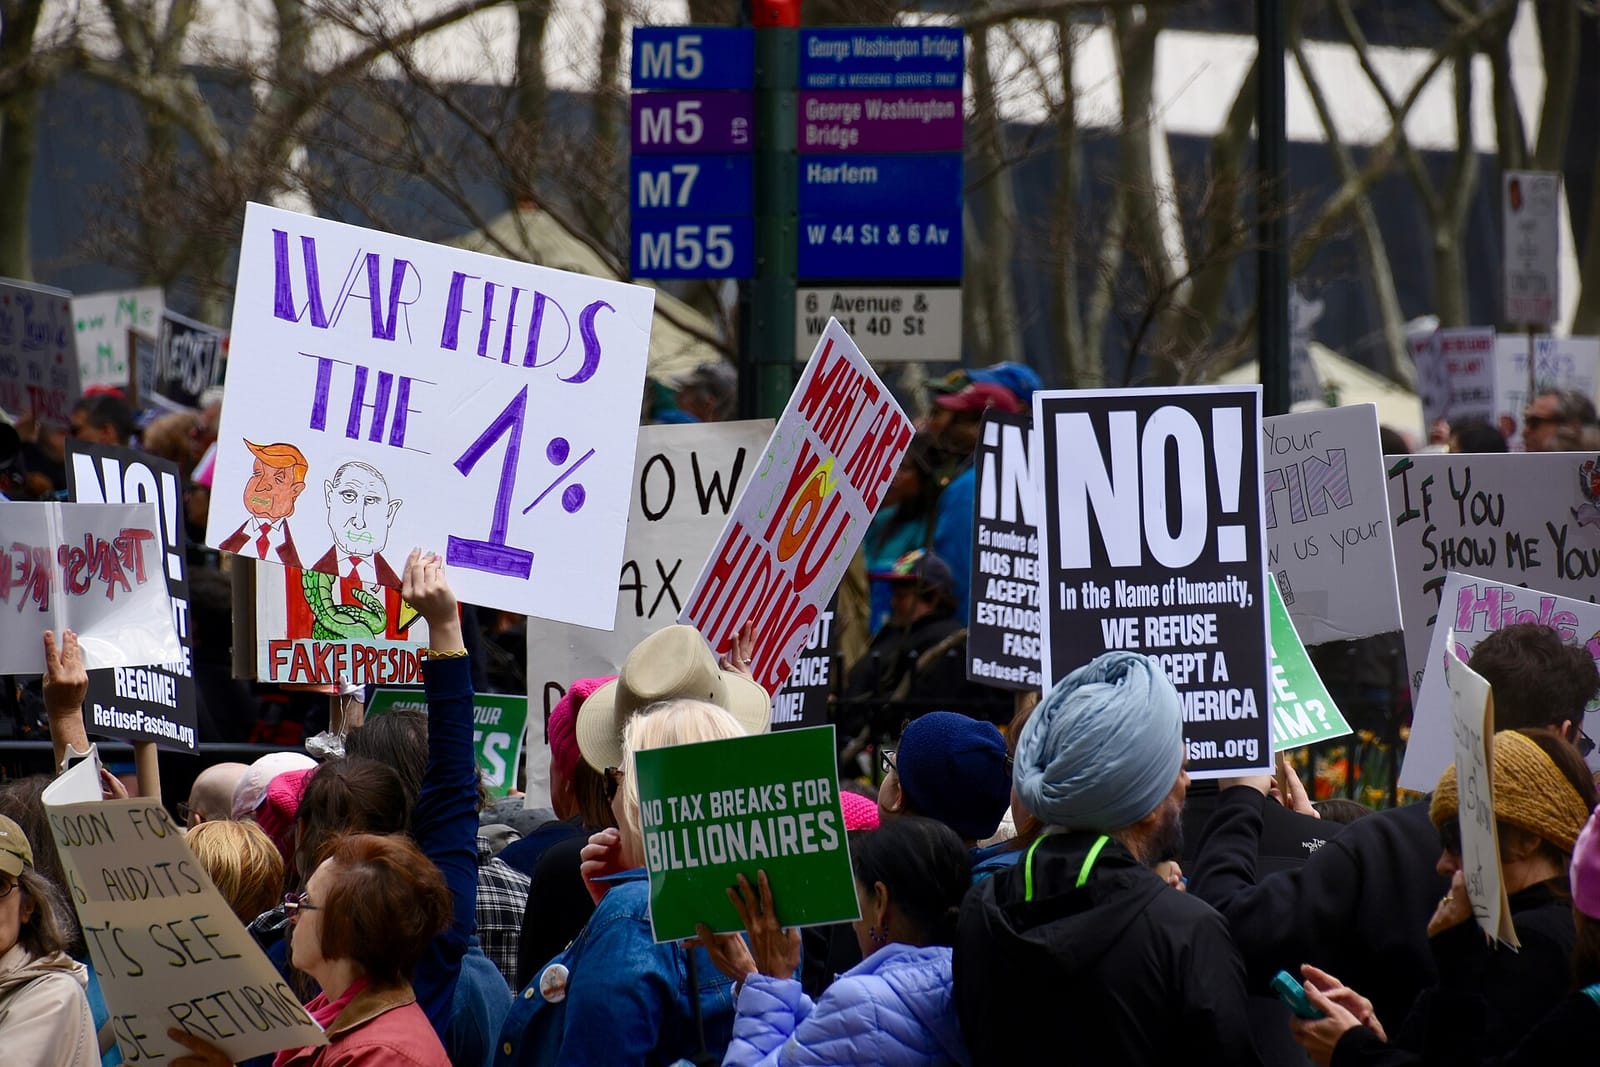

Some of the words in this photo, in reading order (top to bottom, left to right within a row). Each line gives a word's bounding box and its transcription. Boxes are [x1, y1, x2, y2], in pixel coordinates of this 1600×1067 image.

[640, 35, 703, 79] M5
[808, 36, 850, 62] George
[853, 36, 919, 62] Washington
[922, 35, 959, 62] Bridge
[640, 100, 703, 144] M5
[806, 99, 861, 125] George
[865, 99, 955, 124] Washington
[806, 124, 858, 149] Bridge
[638, 165, 699, 207] M7
[807, 163, 878, 184] Harlem
[640, 225, 733, 270] M55
[808, 225, 825, 244] W
[832, 225, 853, 244] 44
[861, 225, 879, 244] St
[887, 226, 900, 244] &
[908, 225, 919, 244] 6
[926, 225, 949, 244] Av
[271, 228, 422, 344] WAR
[440, 271, 616, 384] FEEDS
[805, 292, 819, 312] 6
[831, 292, 902, 312] Avenue
[913, 293, 928, 312] &
[866, 317, 891, 335] 40
[903, 317, 926, 335] St
[798, 338, 880, 458] WHAT
[844, 401, 912, 514] ARE
[1263, 423, 1322, 455] Your
[297, 351, 438, 455] THE
[446, 384, 596, 580] 1%
[641, 447, 747, 522] OW
[1055, 405, 1248, 569] NO!
[1264, 448, 1353, 530] TIN
[1388, 458, 1435, 526] IF
[764, 438, 851, 594] YOU
[978, 525, 991, 546] En
[991, 528, 1026, 552] nombre
[1506, 531, 1541, 570] ME
[979, 551, 1011, 575] NOS
[618, 558, 683, 619] AX
[1060, 581, 1076, 610] In
[1080, 581, 1110, 610] the
[1114, 579, 1159, 608] Name
[1161, 578, 1176, 606] of
[1177, 575, 1253, 608] Humanity,
[977, 603, 1040, 632] ESTADOS
[1101, 618, 1140, 649] WE
[1144, 613, 1217, 648] REFUSE
[268, 640, 347, 683] FAKE
[352, 643, 428, 684] PRESIDE
[1003, 633, 1041, 660] FASC
[1212, 651, 1229, 682] A
[114, 666, 177, 709] REGIME!
[1178, 688, 1259, 722] MERICA
[93, 704, 195, 750] RefuseFascism.org
[474, 706, 503, 725] OUR
[127, 807, 180, 839] FOR
[641, 800, 663, 828] NO
[667, 793, 702, 823] TAX
[709, 783, 787, 819] BREAKS
[792, 778, 832, 807] FOR
[646, 810, 839, 873] BILLIONAIRES
[101, 861, 202, 902] AUDITS
[149, 915, 242, 967] SEE
[167, 982, 313, 1041] RETURNS
